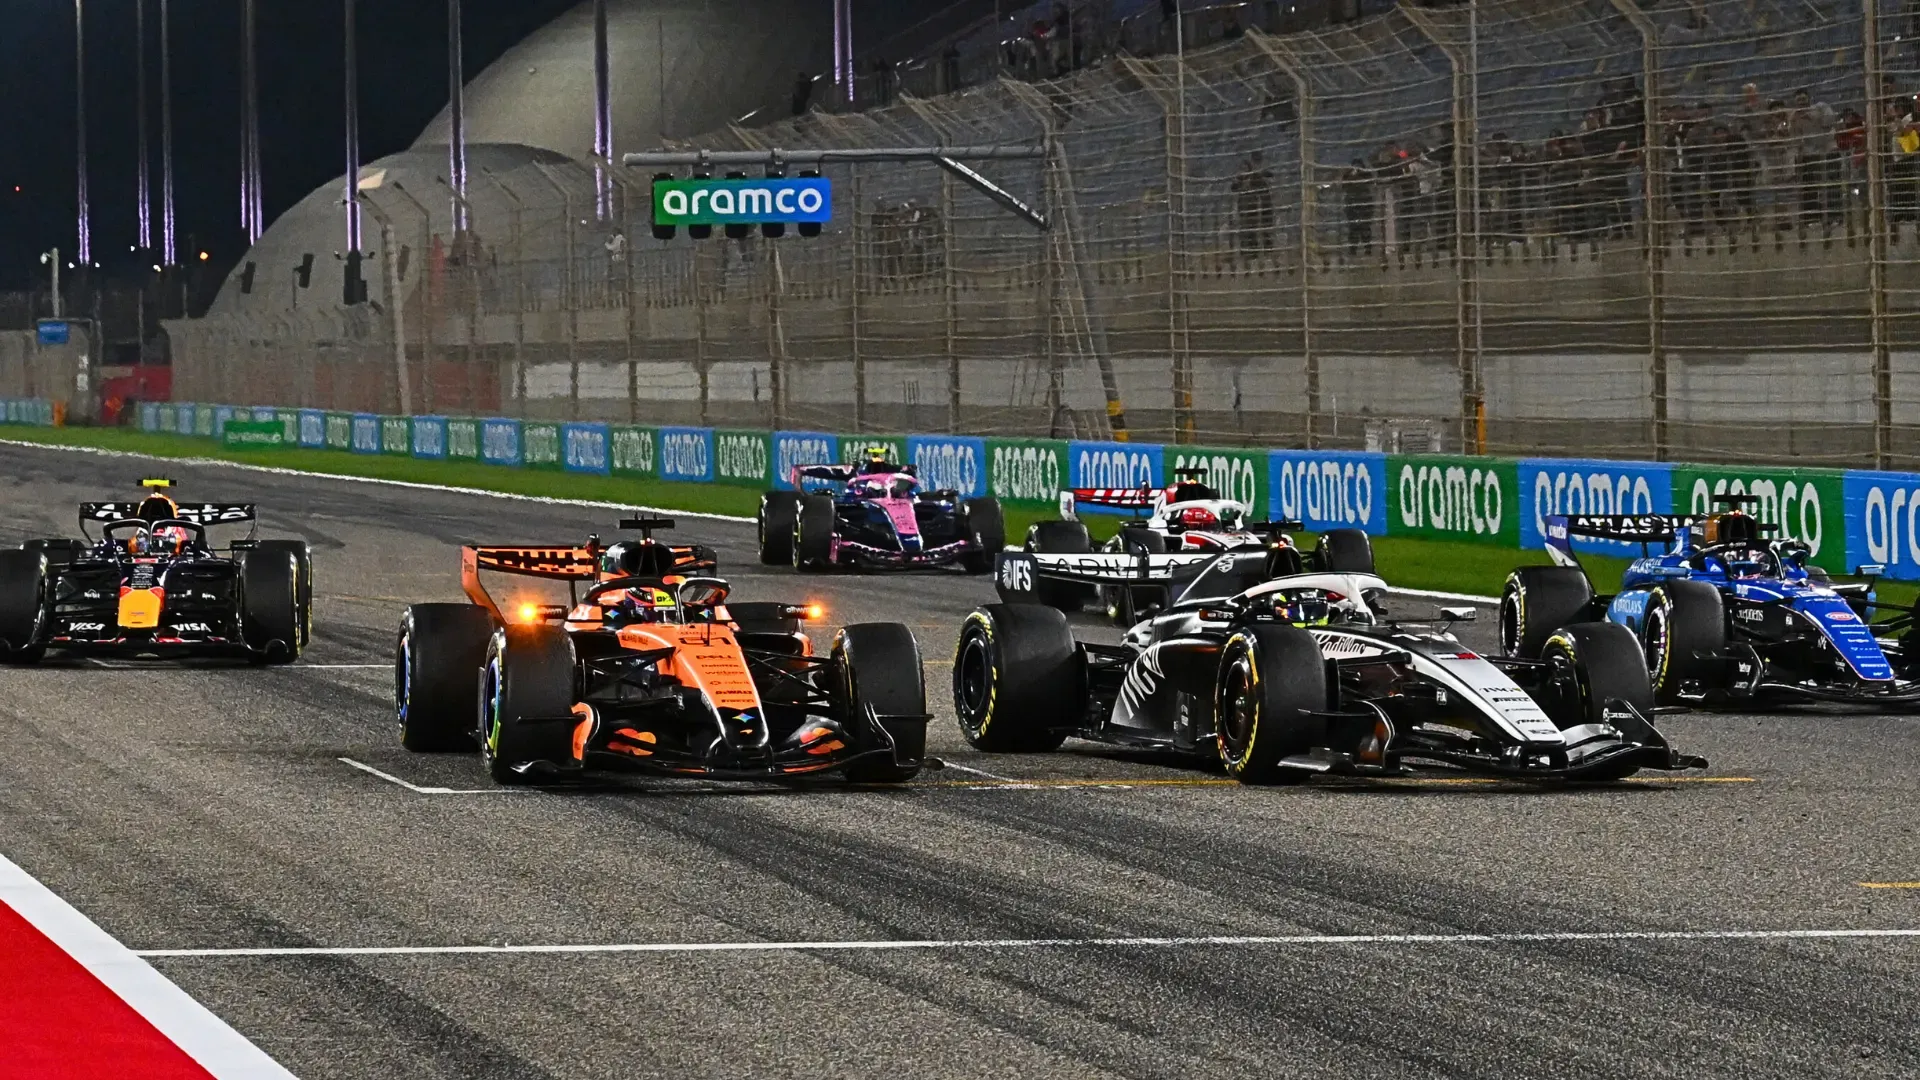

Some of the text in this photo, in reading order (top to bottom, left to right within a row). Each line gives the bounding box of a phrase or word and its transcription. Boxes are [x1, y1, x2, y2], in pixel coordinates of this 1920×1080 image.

[662, 188, 822, 215] aramco
[993, 447, 1059, 502] aramco
[1281, 460, 1371, 525] aramco
[1400, 464, 1502, 535] aramco
[1013, 560, 1031, 591] IFS
[69, 622, 106, 632] VISA
[169, 622, 212, 632] VISA
[1736, 608, 1764, 622] Stephens
[1317, 634, 1367, 655] Cadillac
